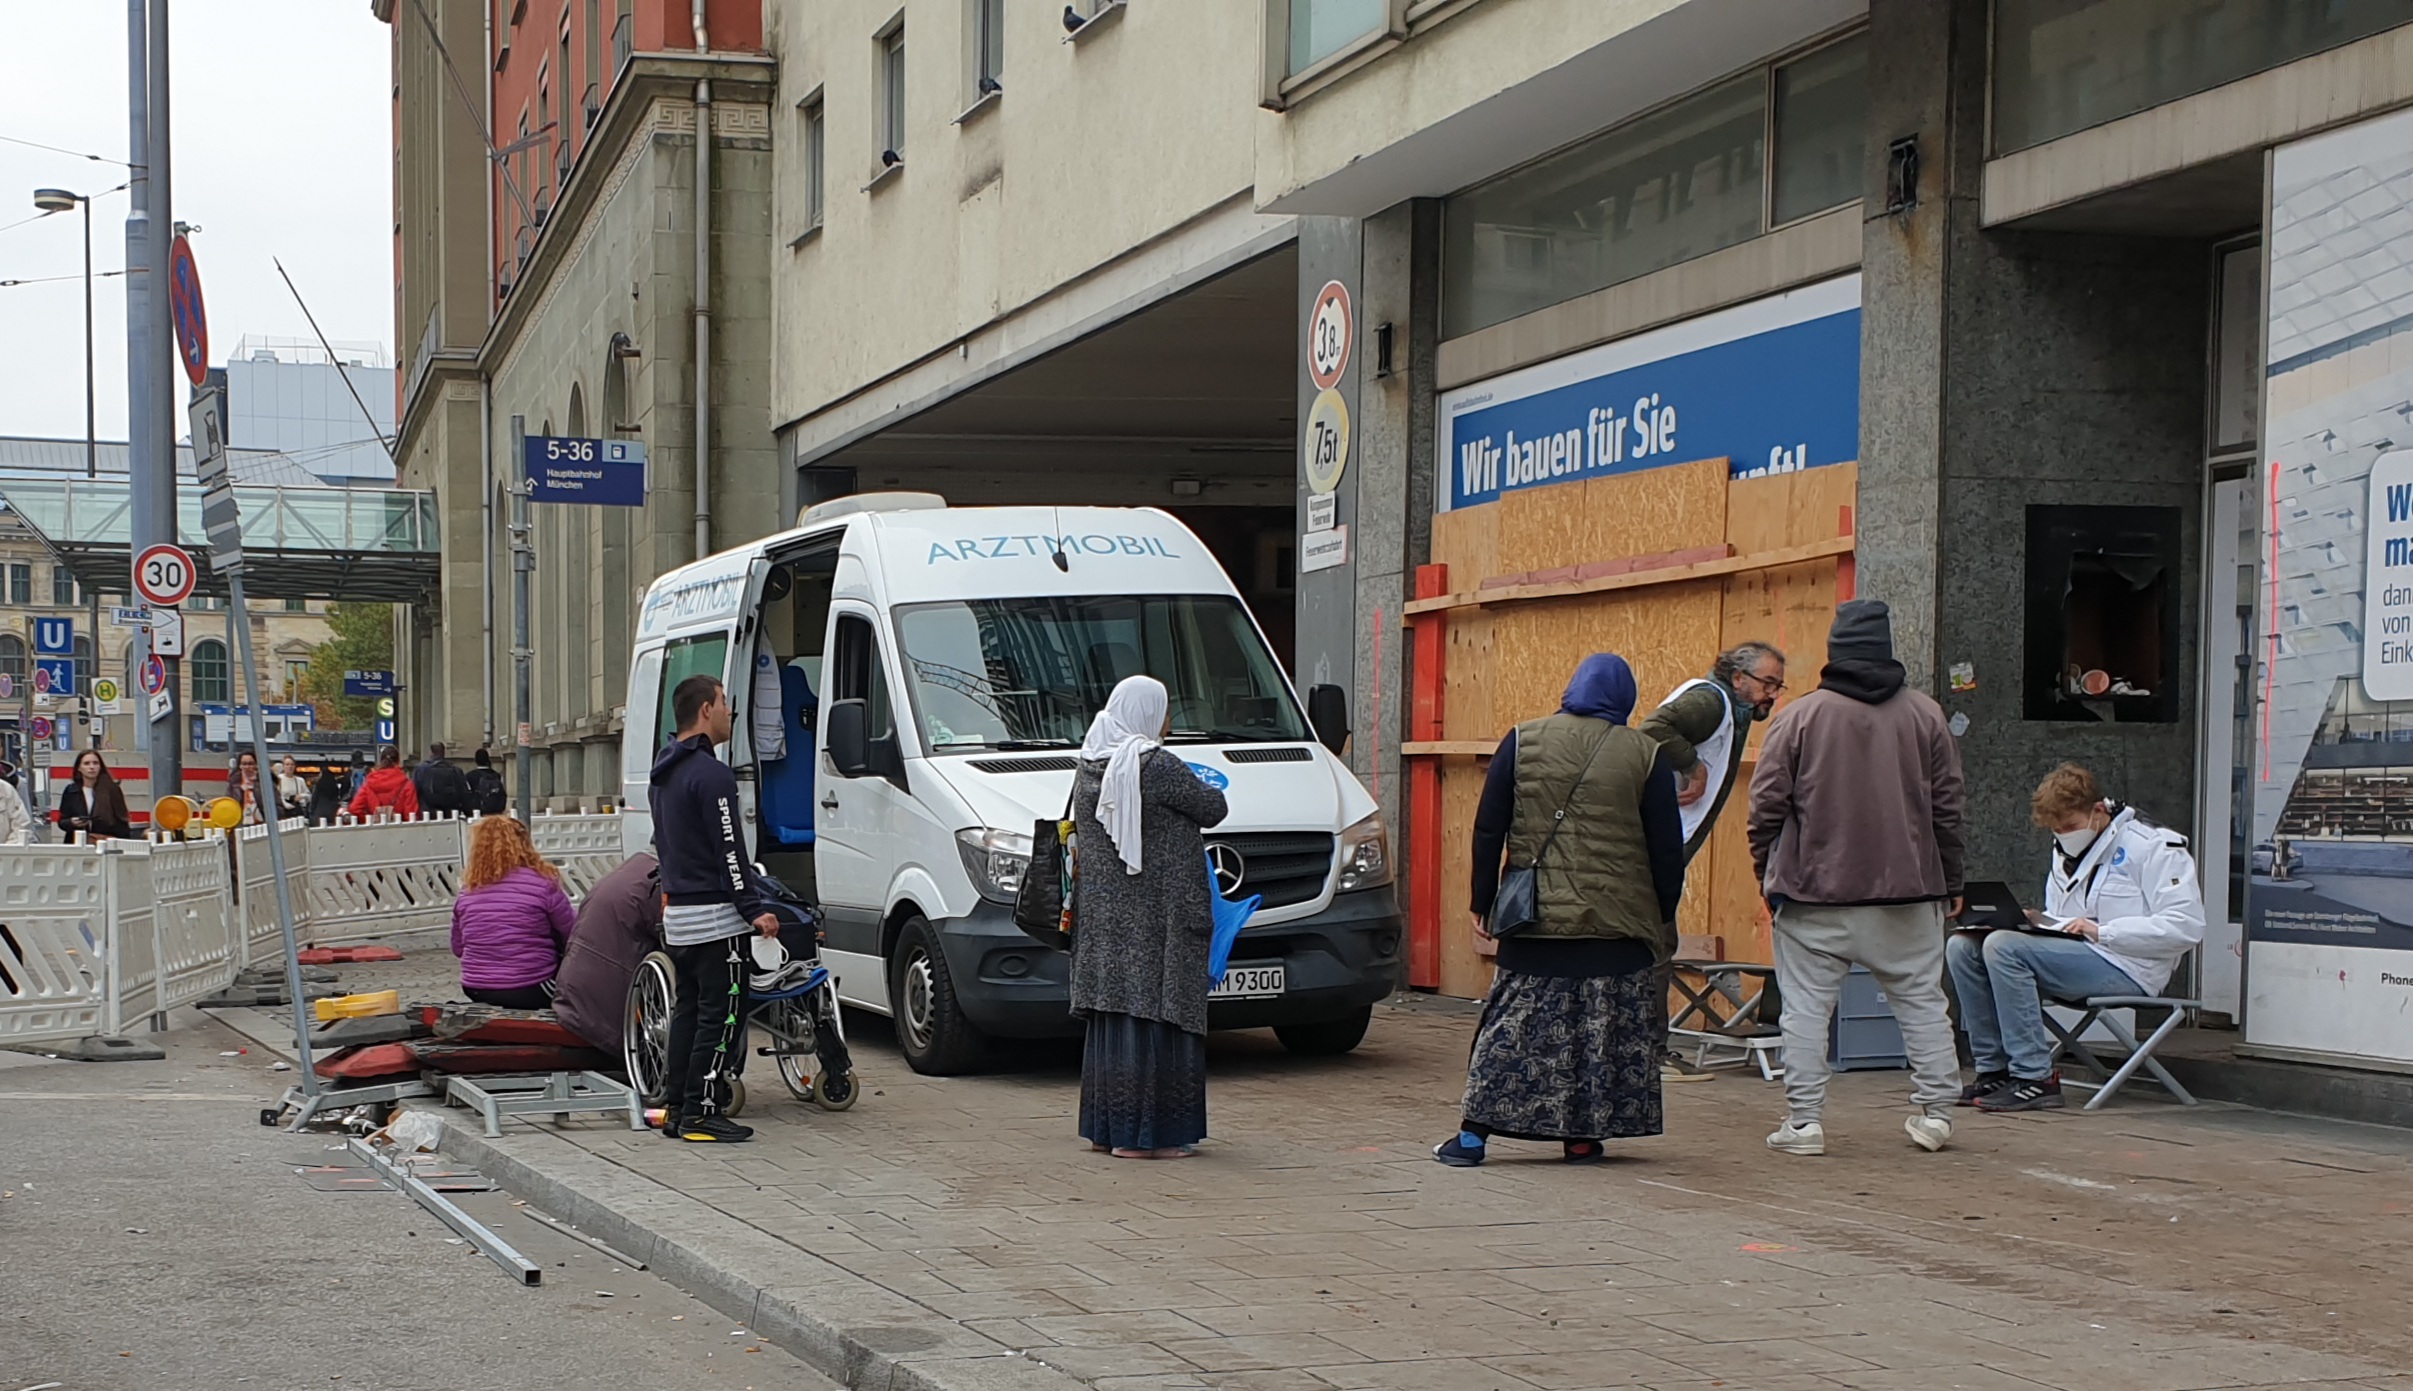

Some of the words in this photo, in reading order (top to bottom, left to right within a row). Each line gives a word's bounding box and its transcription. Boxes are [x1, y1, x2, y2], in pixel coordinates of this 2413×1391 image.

[546, 441, 594, 462] 5-36
[1461, 435, 1502, 497] Wir
[1506, 425, 1581, 487] bauen
[1587, 407, 1628, 468] für
[1633, 392, 1677, 459] Sie
[2386, 482, 2413, 523] W
[928, 533, 1181, 566] ARZTMOBIL
[146, 560, 182, 588] 30
[672, 573, 740, 618] ARZTMOBIL
[2382, 582, 2413, 606] dan
[43, 622, 65, 649] U
[2381, 615, 2411, 635] von
[380, 722, 395, 740] U
[717, 796, 735, 844] SPORT
[724, 850, 745, 892] WEAR
[1235, 970, 1283, 992] 9300
